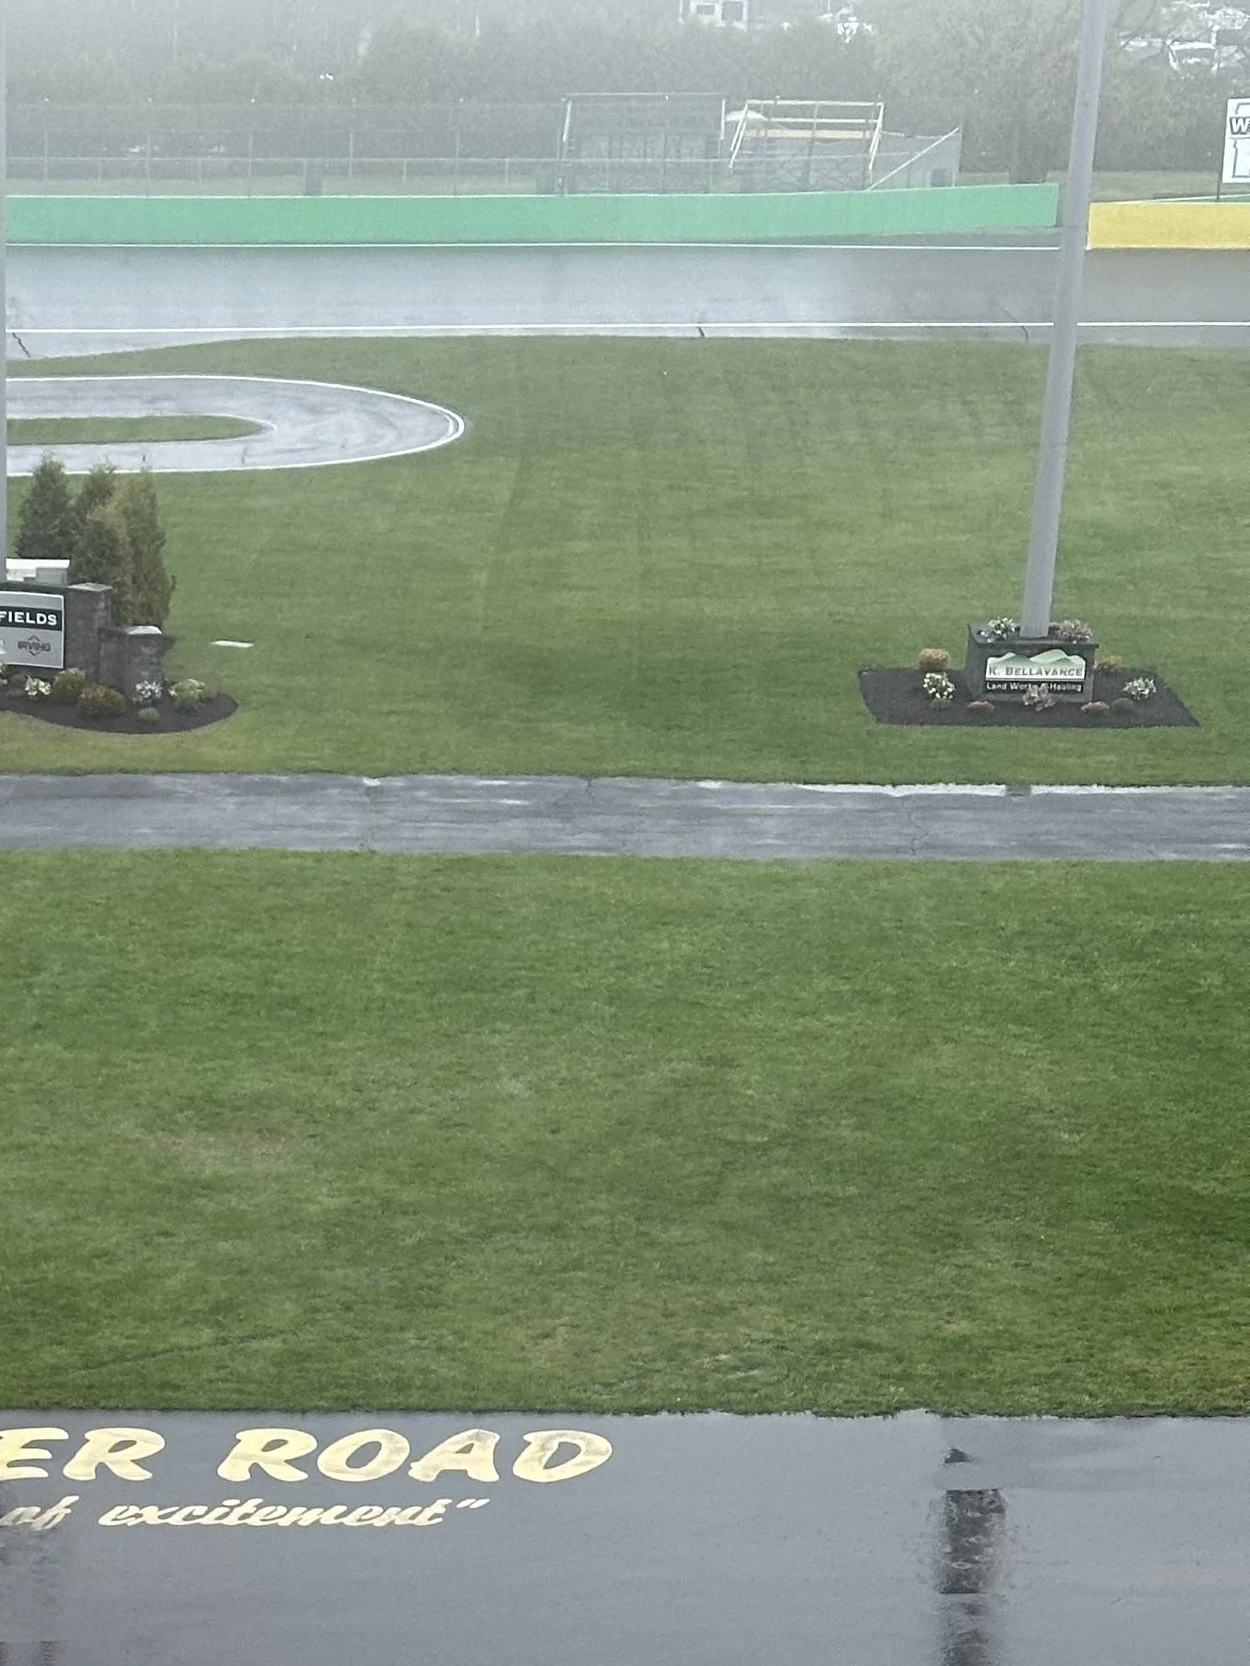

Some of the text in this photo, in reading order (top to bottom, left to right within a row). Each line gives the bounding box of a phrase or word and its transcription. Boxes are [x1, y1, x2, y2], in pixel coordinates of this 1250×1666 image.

[1229, 116, 1250, 135] W
[1005, 666, 1083, 677] BELLAVANCE
[217, 1428, 613, 1483] ROAD
